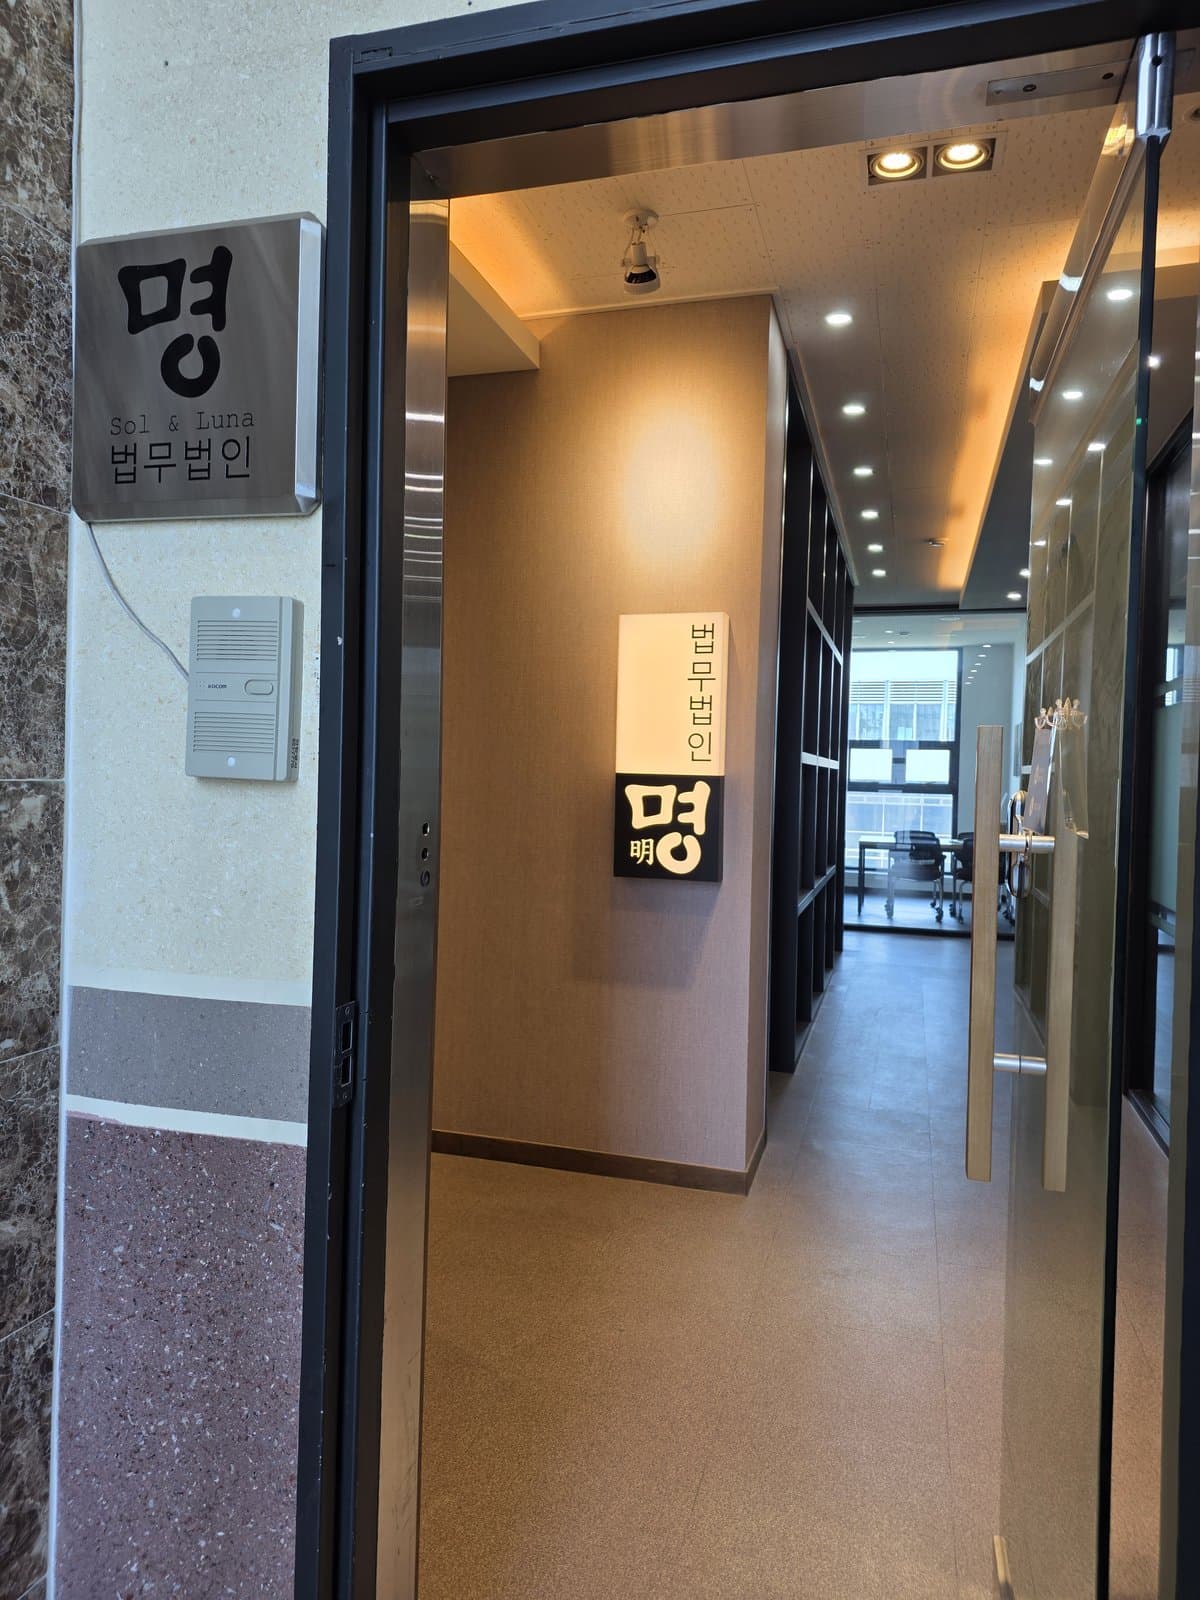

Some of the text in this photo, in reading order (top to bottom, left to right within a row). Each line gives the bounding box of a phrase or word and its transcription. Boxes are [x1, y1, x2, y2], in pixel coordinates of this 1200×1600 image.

[117, 245, 233, 398] 명
[110, 411, 255, 436] Sol & Luna
[111, 435, 250, 485] 법무법인
[687, 623, 716, 762] 법무법인
[624, 780, 711, 875] 명
[630, 838, 655, 866] 明
